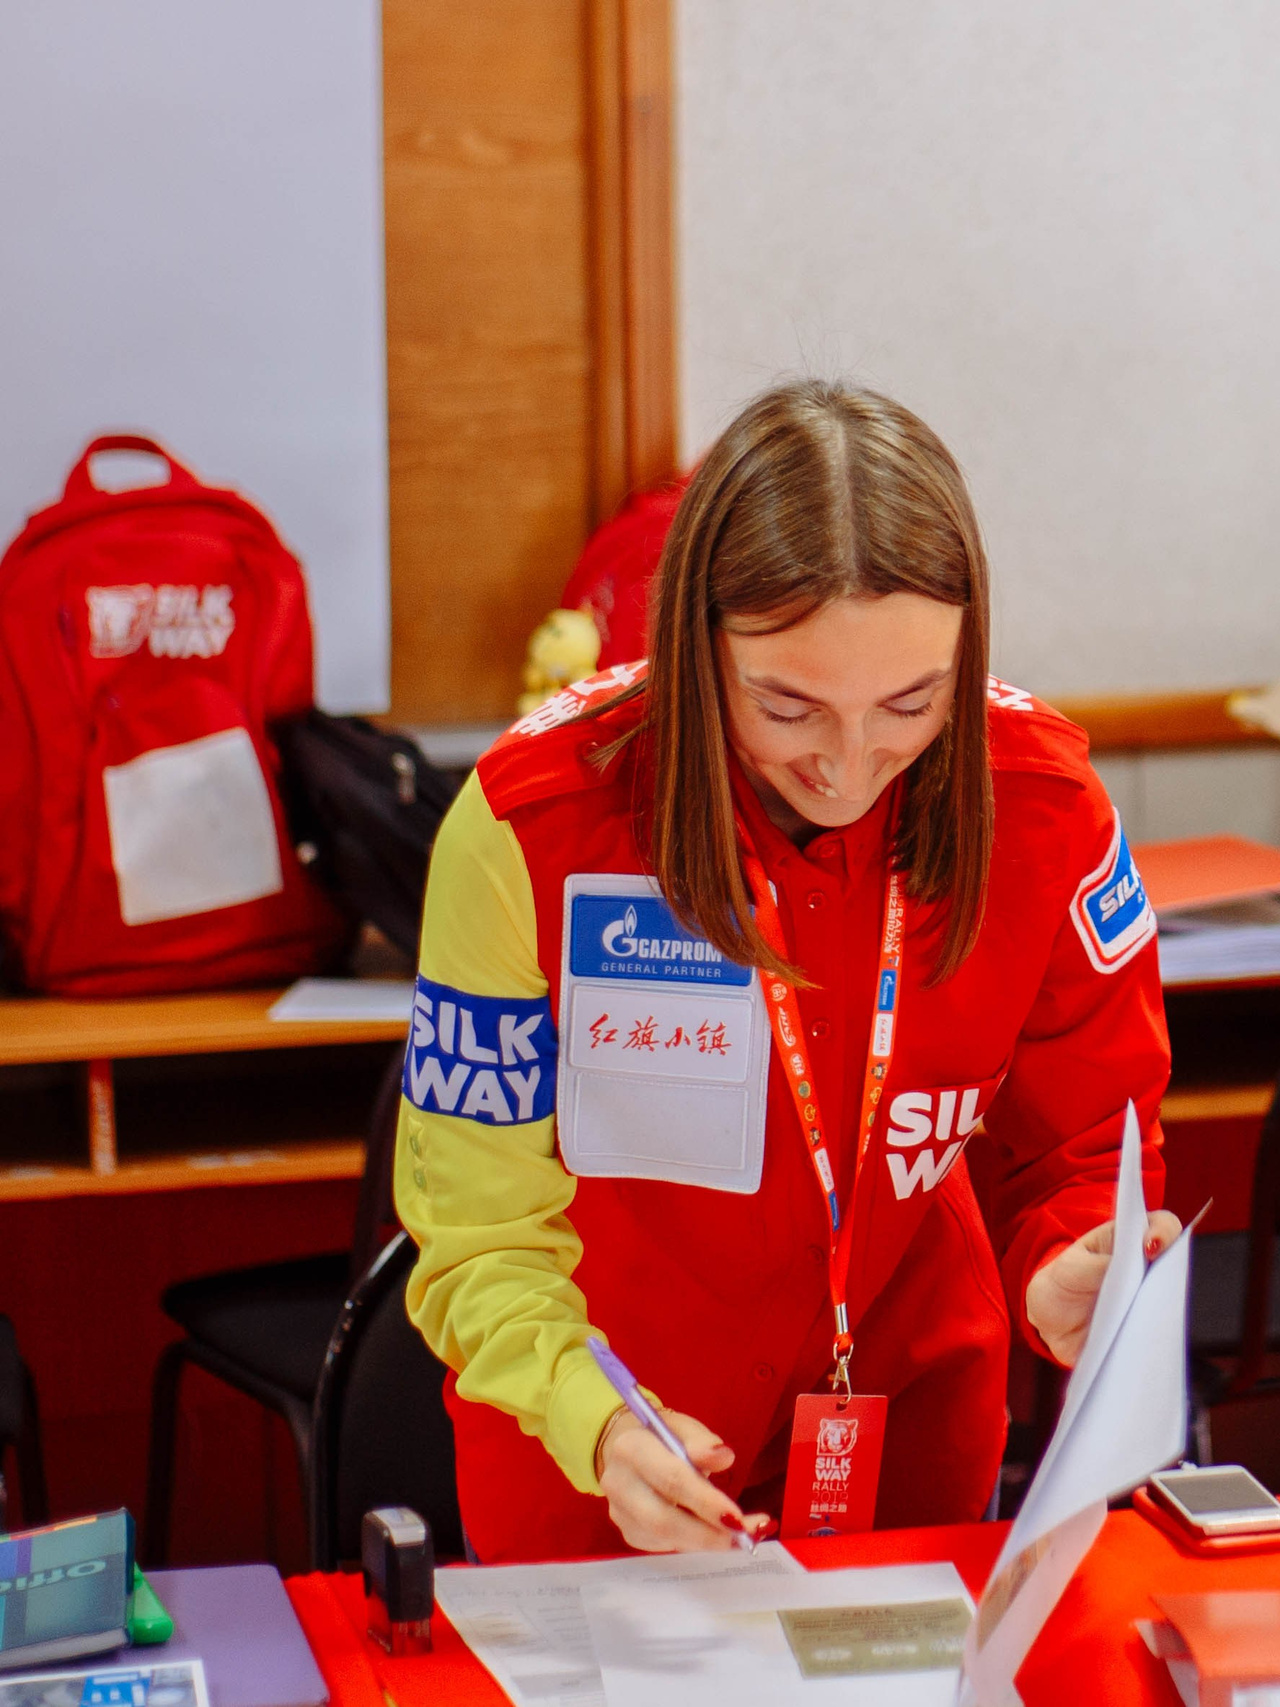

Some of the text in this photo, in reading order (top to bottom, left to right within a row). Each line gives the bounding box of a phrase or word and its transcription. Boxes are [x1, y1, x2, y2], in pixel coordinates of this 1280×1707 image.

[638, 938, 723, 963] GAZPROM
[601, 962, 722, 978] GENERAL PARTNER
[413, 990, 545, 1066] SILK
[588, 1013, 733, 1056] 红旗小镇
[410, 1046, 542, 1122] WAY
[886, 1086, 985, 1147] SIL
[885, 1140, 964, 1201] W
[815, 1457, 852, 1470] SILK
[815, 1469, 852, 1481] WAY
[812, 1481, 849, 1492] RALLY
